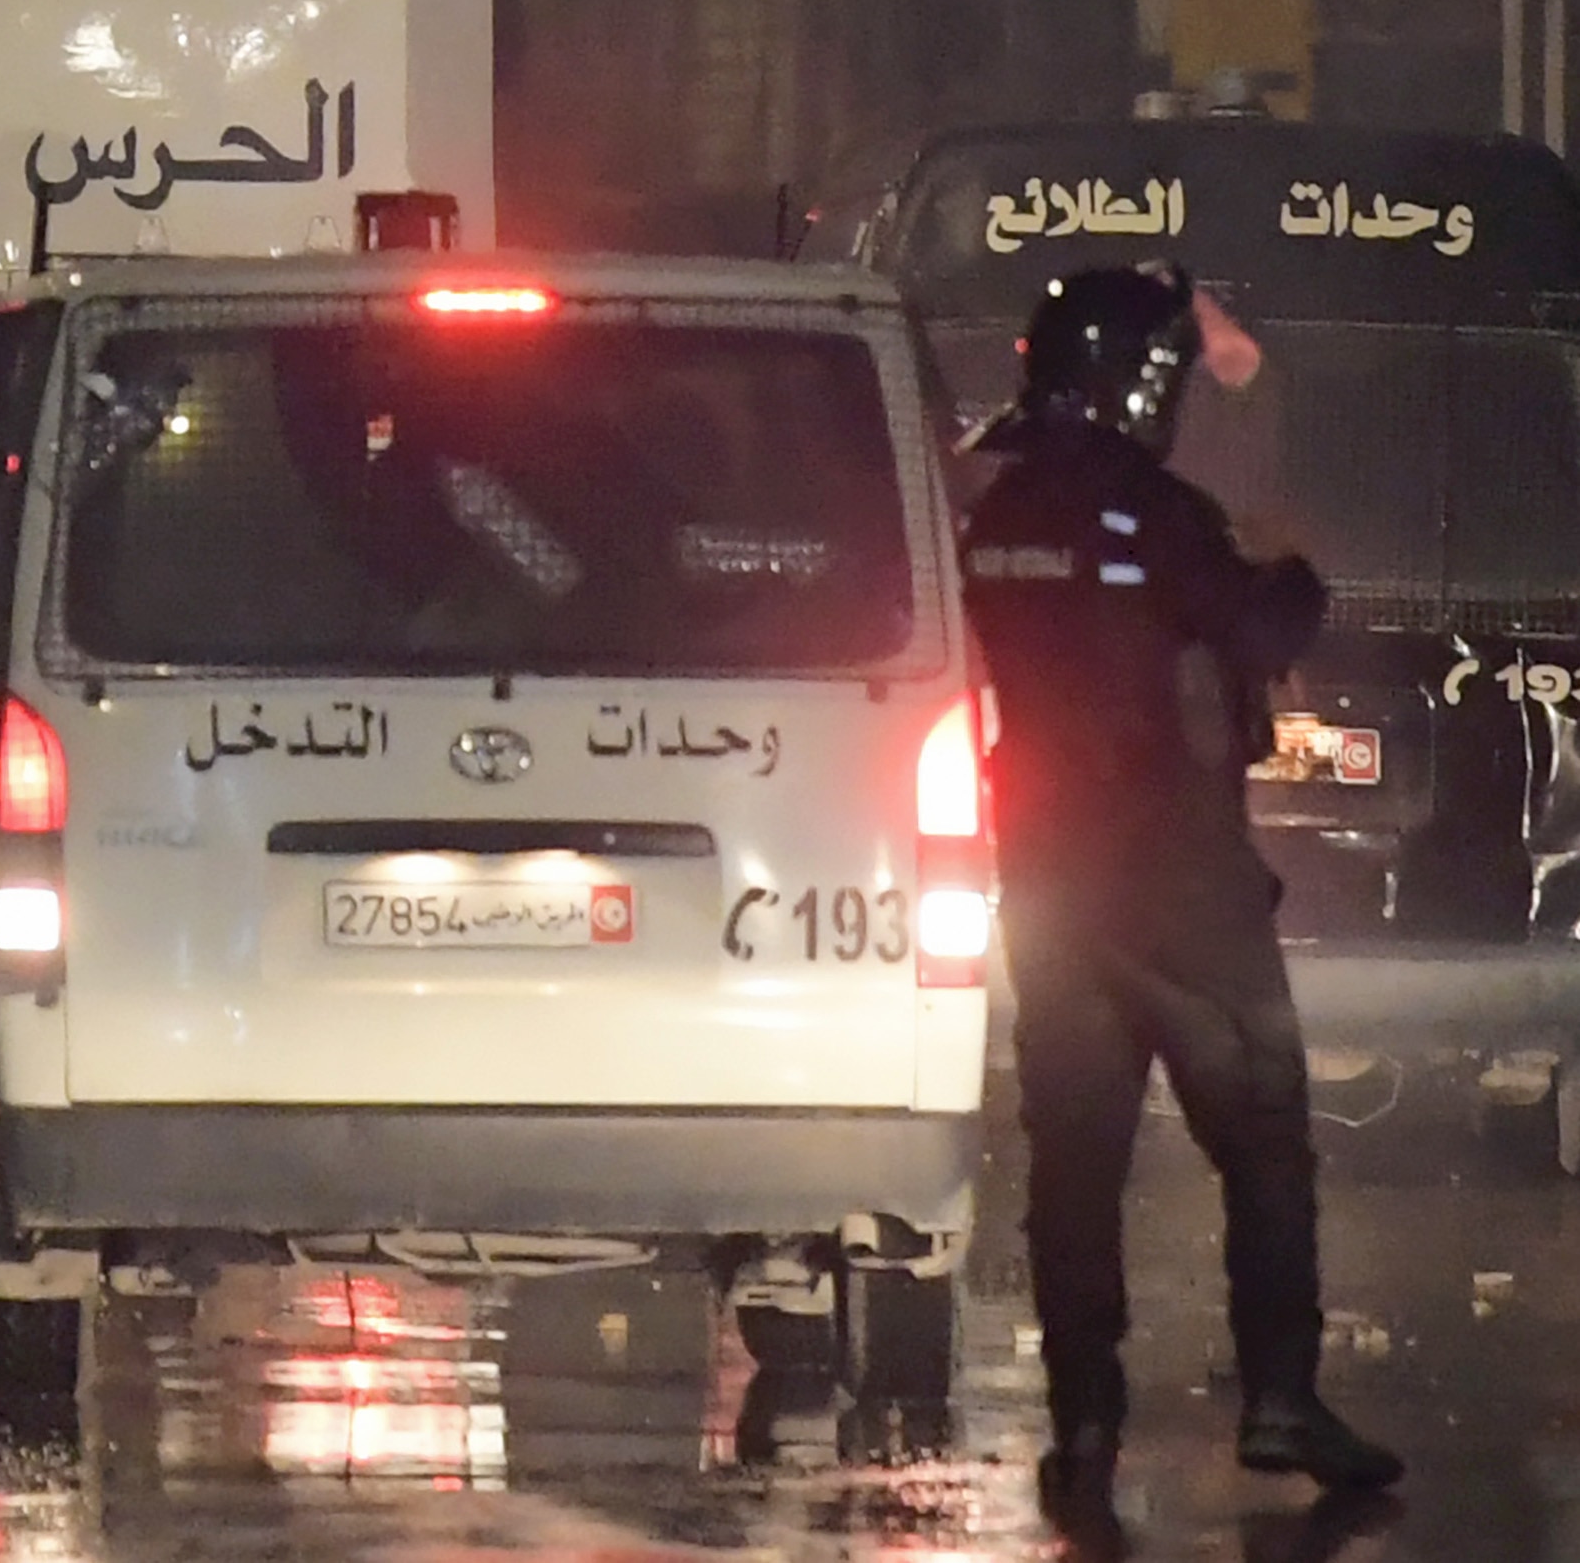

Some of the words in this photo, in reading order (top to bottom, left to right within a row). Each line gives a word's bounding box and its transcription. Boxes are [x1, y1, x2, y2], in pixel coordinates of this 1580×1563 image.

[25, 79, 356, 209] الحرس
[984, 176, 1186, 254] الطلائع
[1279, 180, 1475, 257] وحدات
[1494, 661, 1580, 705] 19
[185, 700, 390, 773] التدخل
[585, 702, 781, 778] وحدات
[335, 893, 468, 937] 27854
[791, 884, 911, 965] 193
